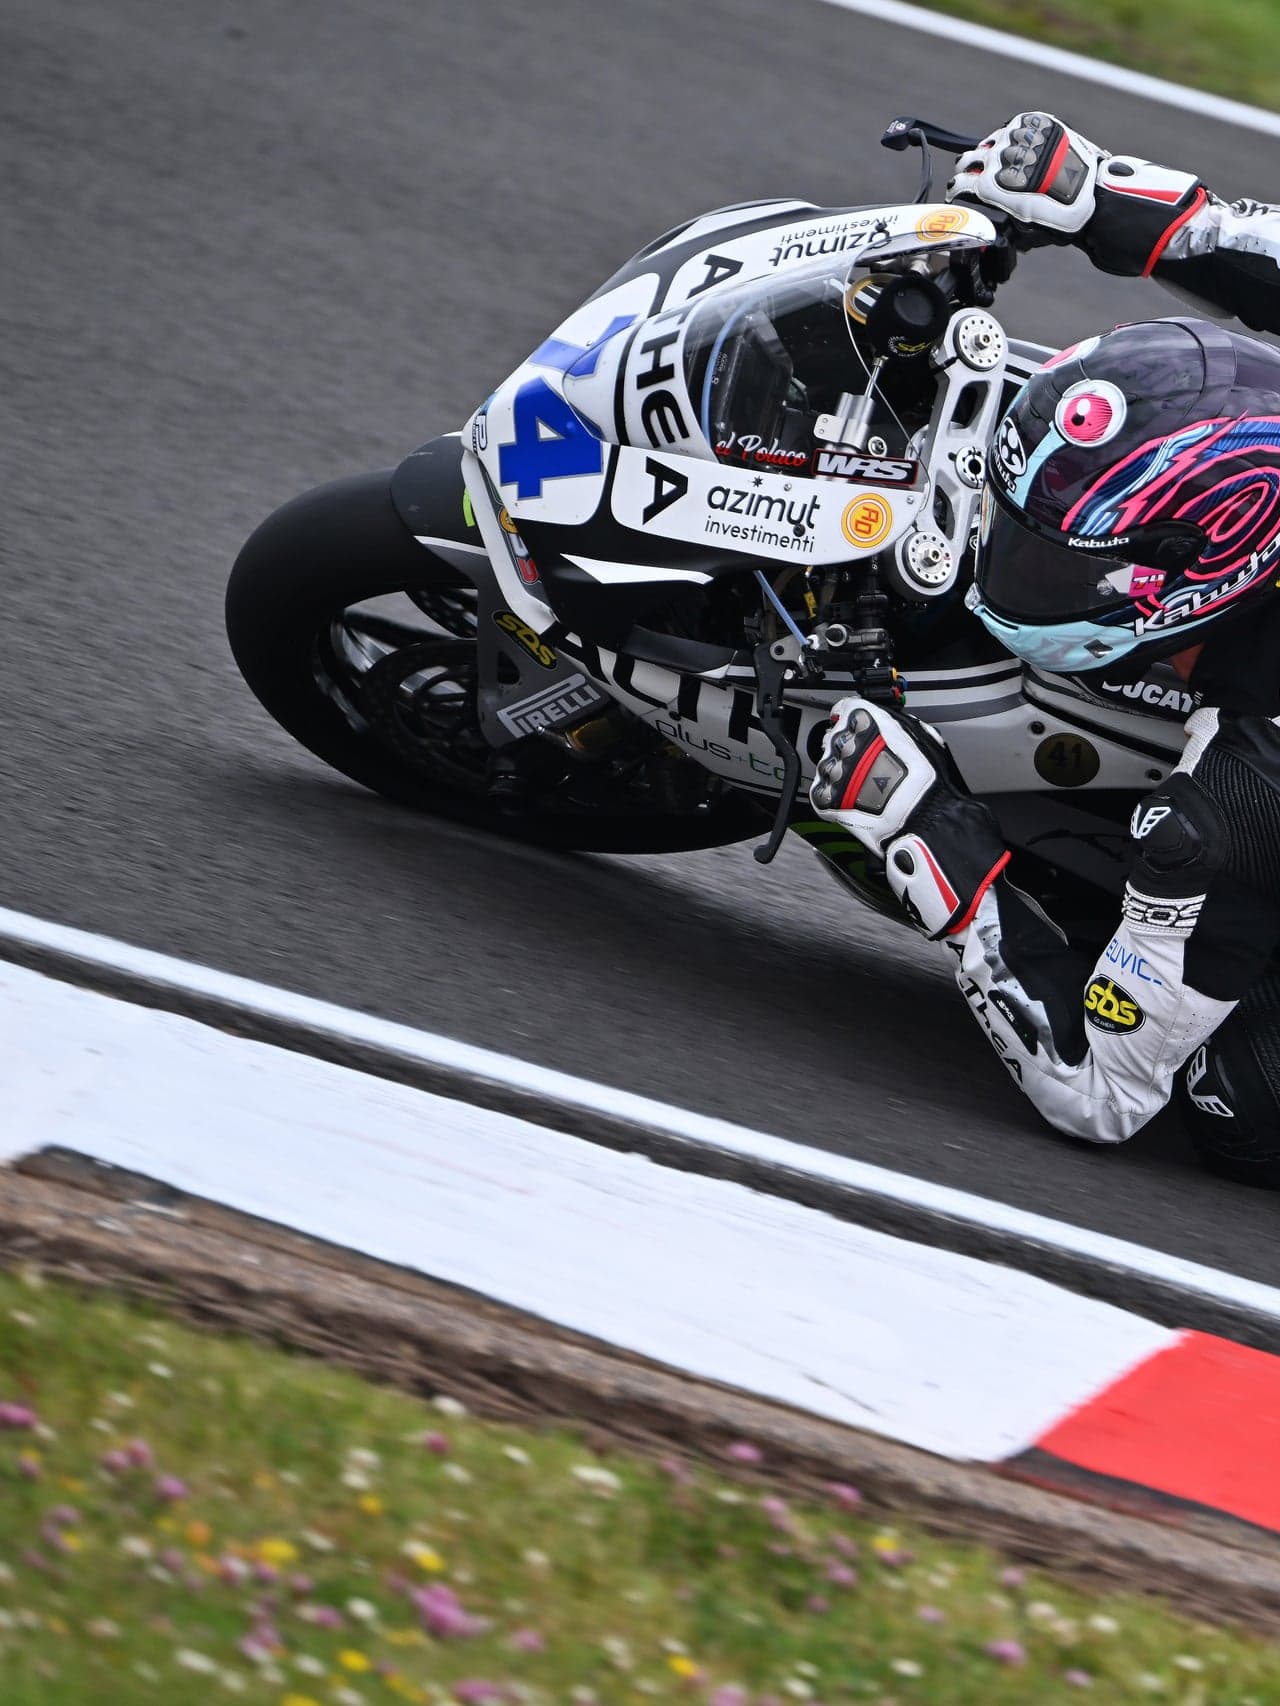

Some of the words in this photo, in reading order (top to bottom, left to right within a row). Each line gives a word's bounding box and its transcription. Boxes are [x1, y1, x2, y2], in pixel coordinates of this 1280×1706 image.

[817, 452, 913, 480] WRS
[706, 483, 821, 529] azimut
[704, 515, 816, 553] investimenti
[1067, 534, 1130, 549] Kabuto
[496, 673, 601, 738] PIRELLI
[1084, 981, 1138, 1026] sbs
